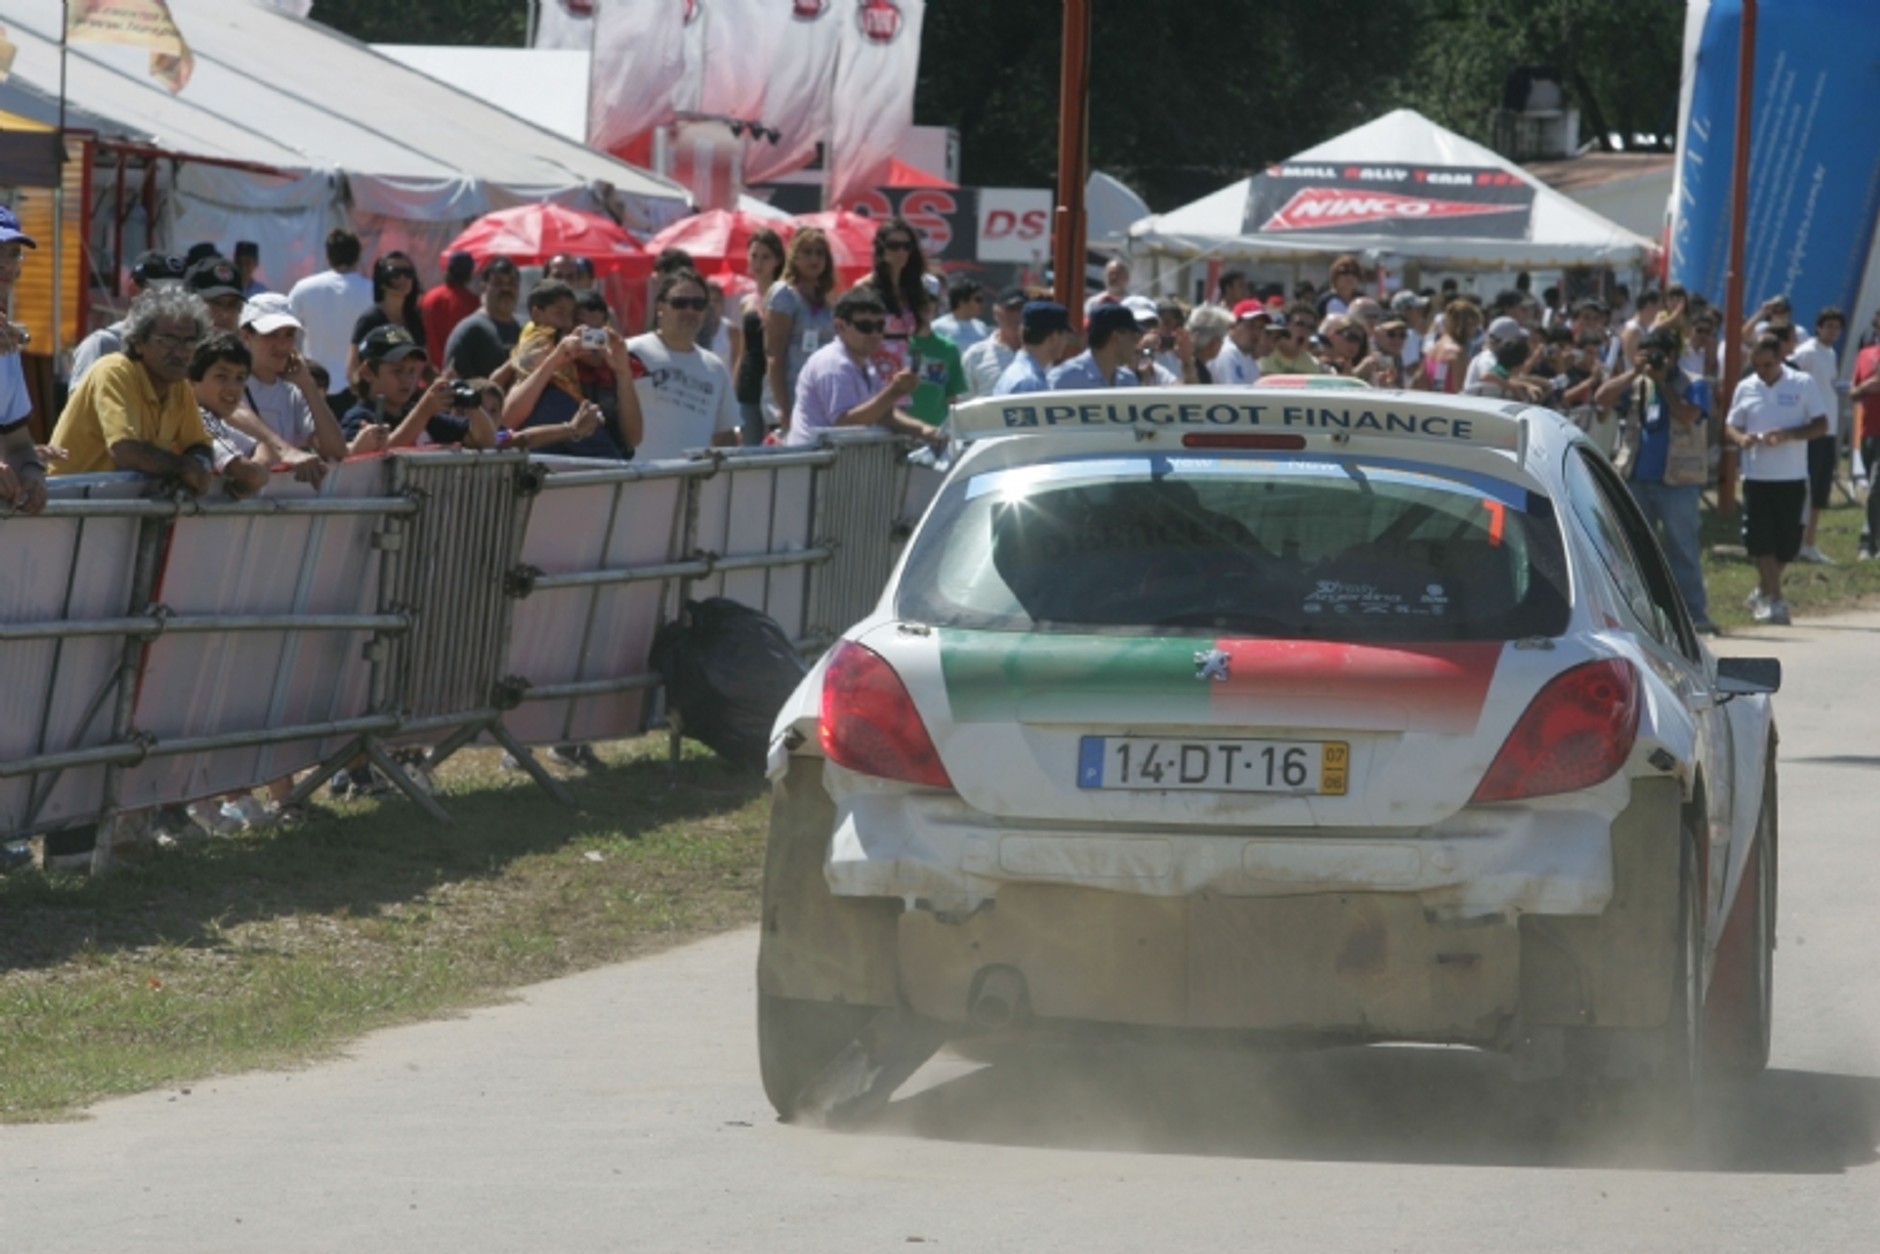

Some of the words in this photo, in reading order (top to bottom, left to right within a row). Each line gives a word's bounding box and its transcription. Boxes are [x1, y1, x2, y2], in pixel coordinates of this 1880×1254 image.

[1343, 165, 1408, 181] RALLY
[1414, 168, 1473, 186] TEAM
[1290, 198, 1430, 218] NINCO
[983, 209, 1047, 242] DS
[1044, 404, 1268, 426] PEUGEOT
[1283, 406, 1473, 440] FINANCE
[1325, 747, 1345, 763] 07
